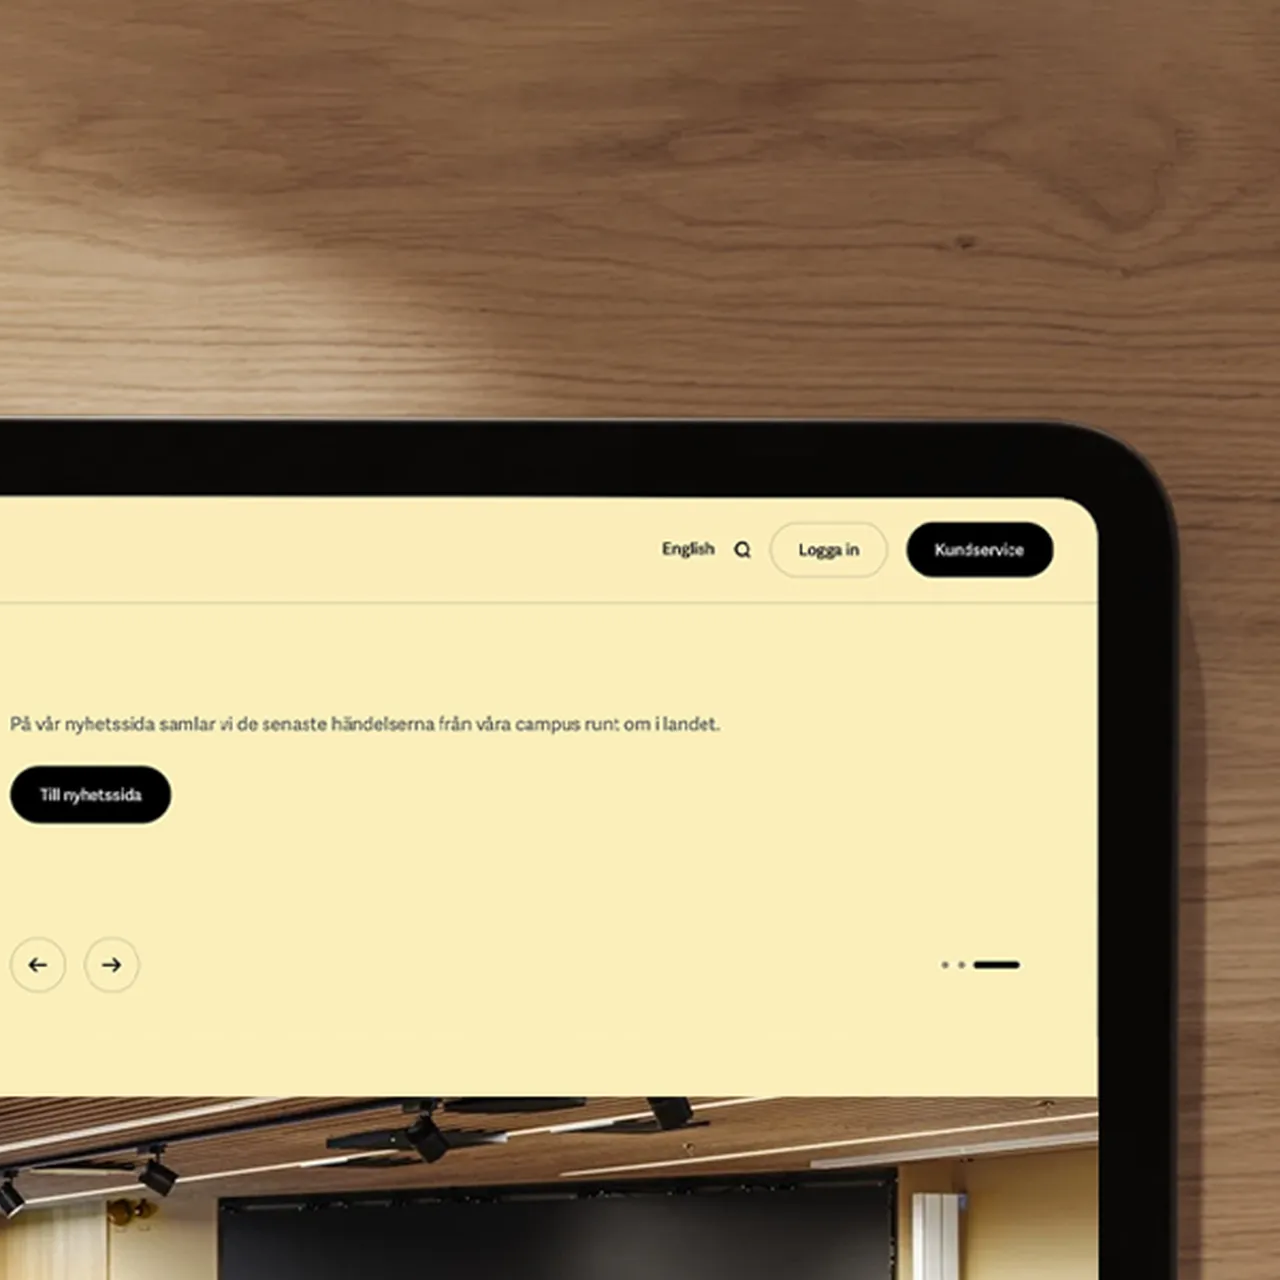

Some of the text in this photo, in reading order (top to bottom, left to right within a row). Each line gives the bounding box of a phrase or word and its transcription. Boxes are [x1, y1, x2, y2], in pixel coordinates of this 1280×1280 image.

[662, 542, 715, 560] English
[799, 543, 860, 561] Logga in
[935, 543, 1025, 558] Kundservice
[11, 715, 721, 736] På vår nyhetssida samlar vi de senaste händelserna från våra campus runt om i landet.
[40, 786, 143, 806] Till nyhetssida
